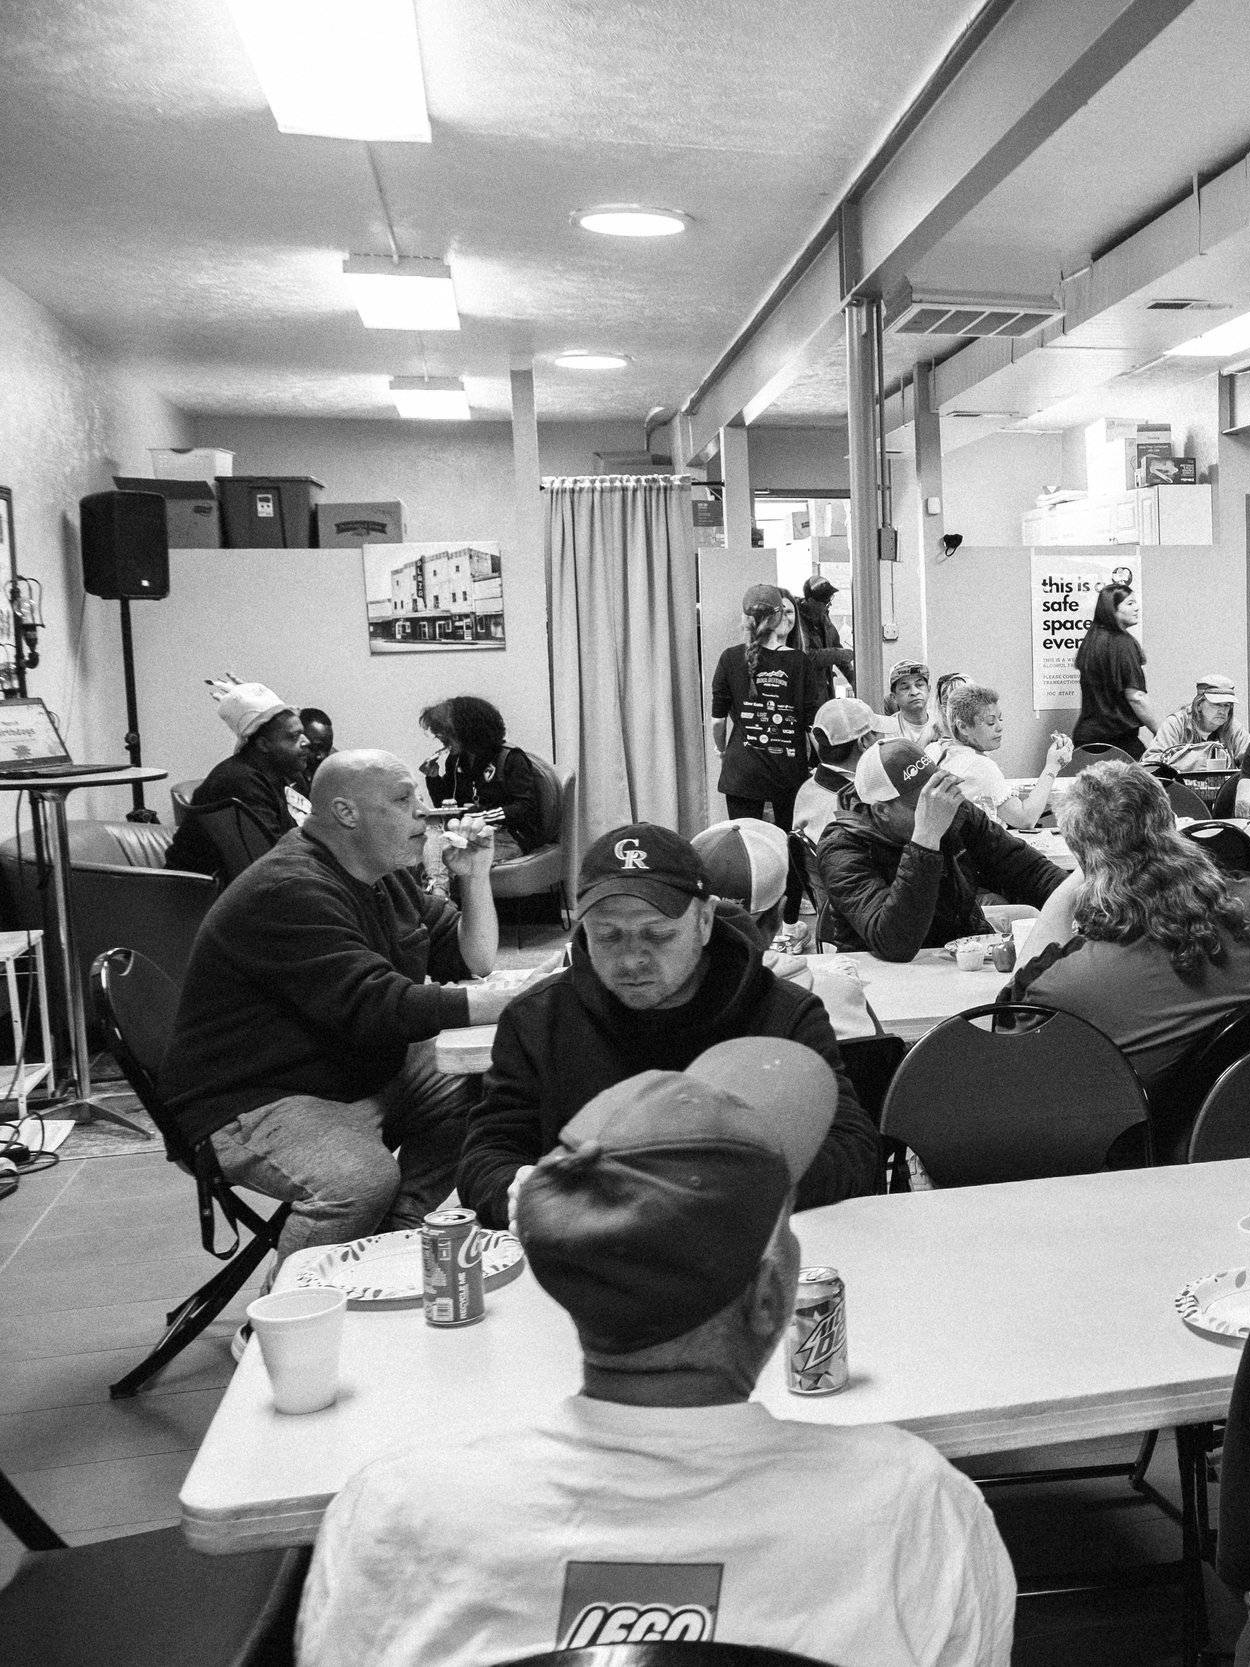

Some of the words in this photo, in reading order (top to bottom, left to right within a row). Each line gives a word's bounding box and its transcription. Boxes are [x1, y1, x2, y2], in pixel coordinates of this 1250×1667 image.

[1041, 576, 1073, 593] this
[1077, 576, 1091, 593] is
[1042, 594, 1079, 612] safe
[1042, 619, 1093, 636] space
[458, 1284, 468, 1319] RECYCLE
